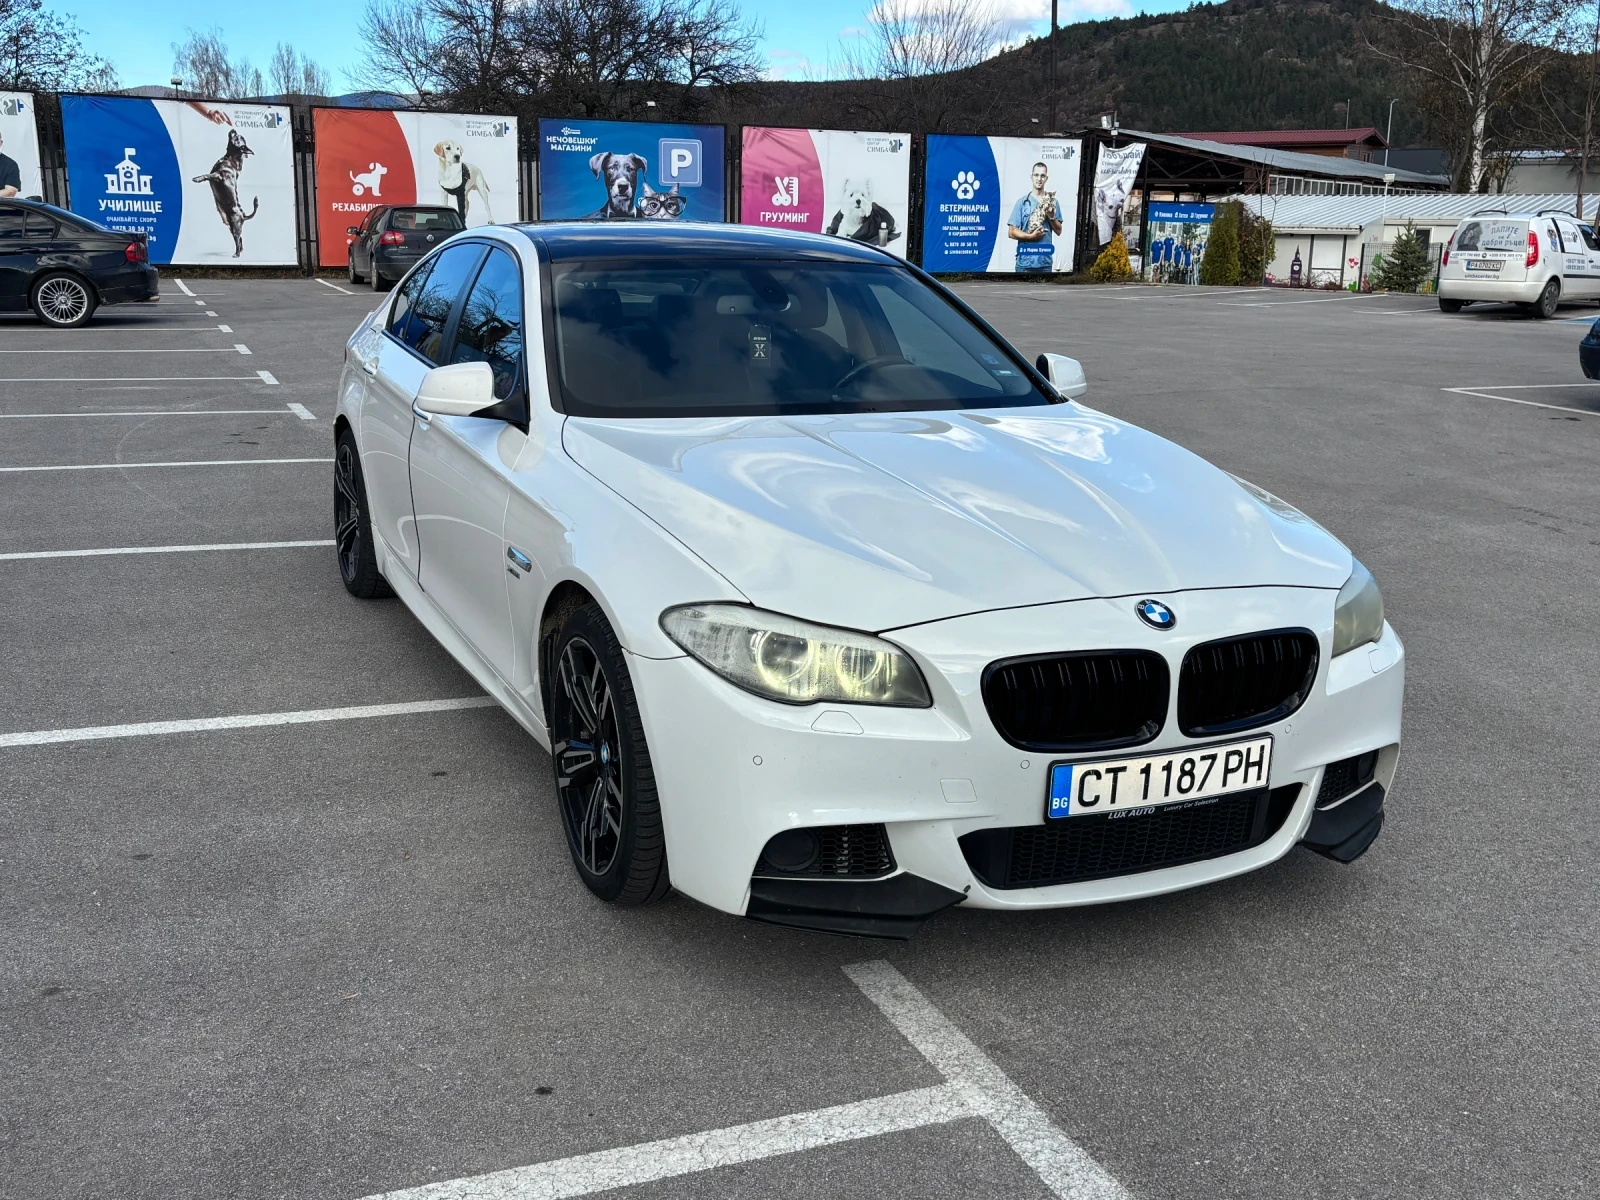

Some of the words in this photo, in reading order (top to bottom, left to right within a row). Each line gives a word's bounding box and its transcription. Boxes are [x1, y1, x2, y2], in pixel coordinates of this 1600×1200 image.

[550, 144, 592, 152] МАГАЗИНИ
[671, 149, 693, 177] P
[98, 199, 163, 214] УЧИЛИЩЕ
[940, 204, 989, 212] ВЕТЕРИНАРНА
[760, 212, 810, 223] ГРУУМИНГ
[948, 215, 980, 223] КЛИНИКА
[1077, 766, 1127, 807] CT
[1140, 753, 1218, 800] 1187
[1222, 744, 1265, 787] PH
[1052, 797, 1068, 809] BG
[1163, 804, 1183, 812] Luxury
[1194, 798, 1219, 807] Selection
[1108, 811, 1127, 820] LUX
[1129, 807, 1155, 816] AUTO
